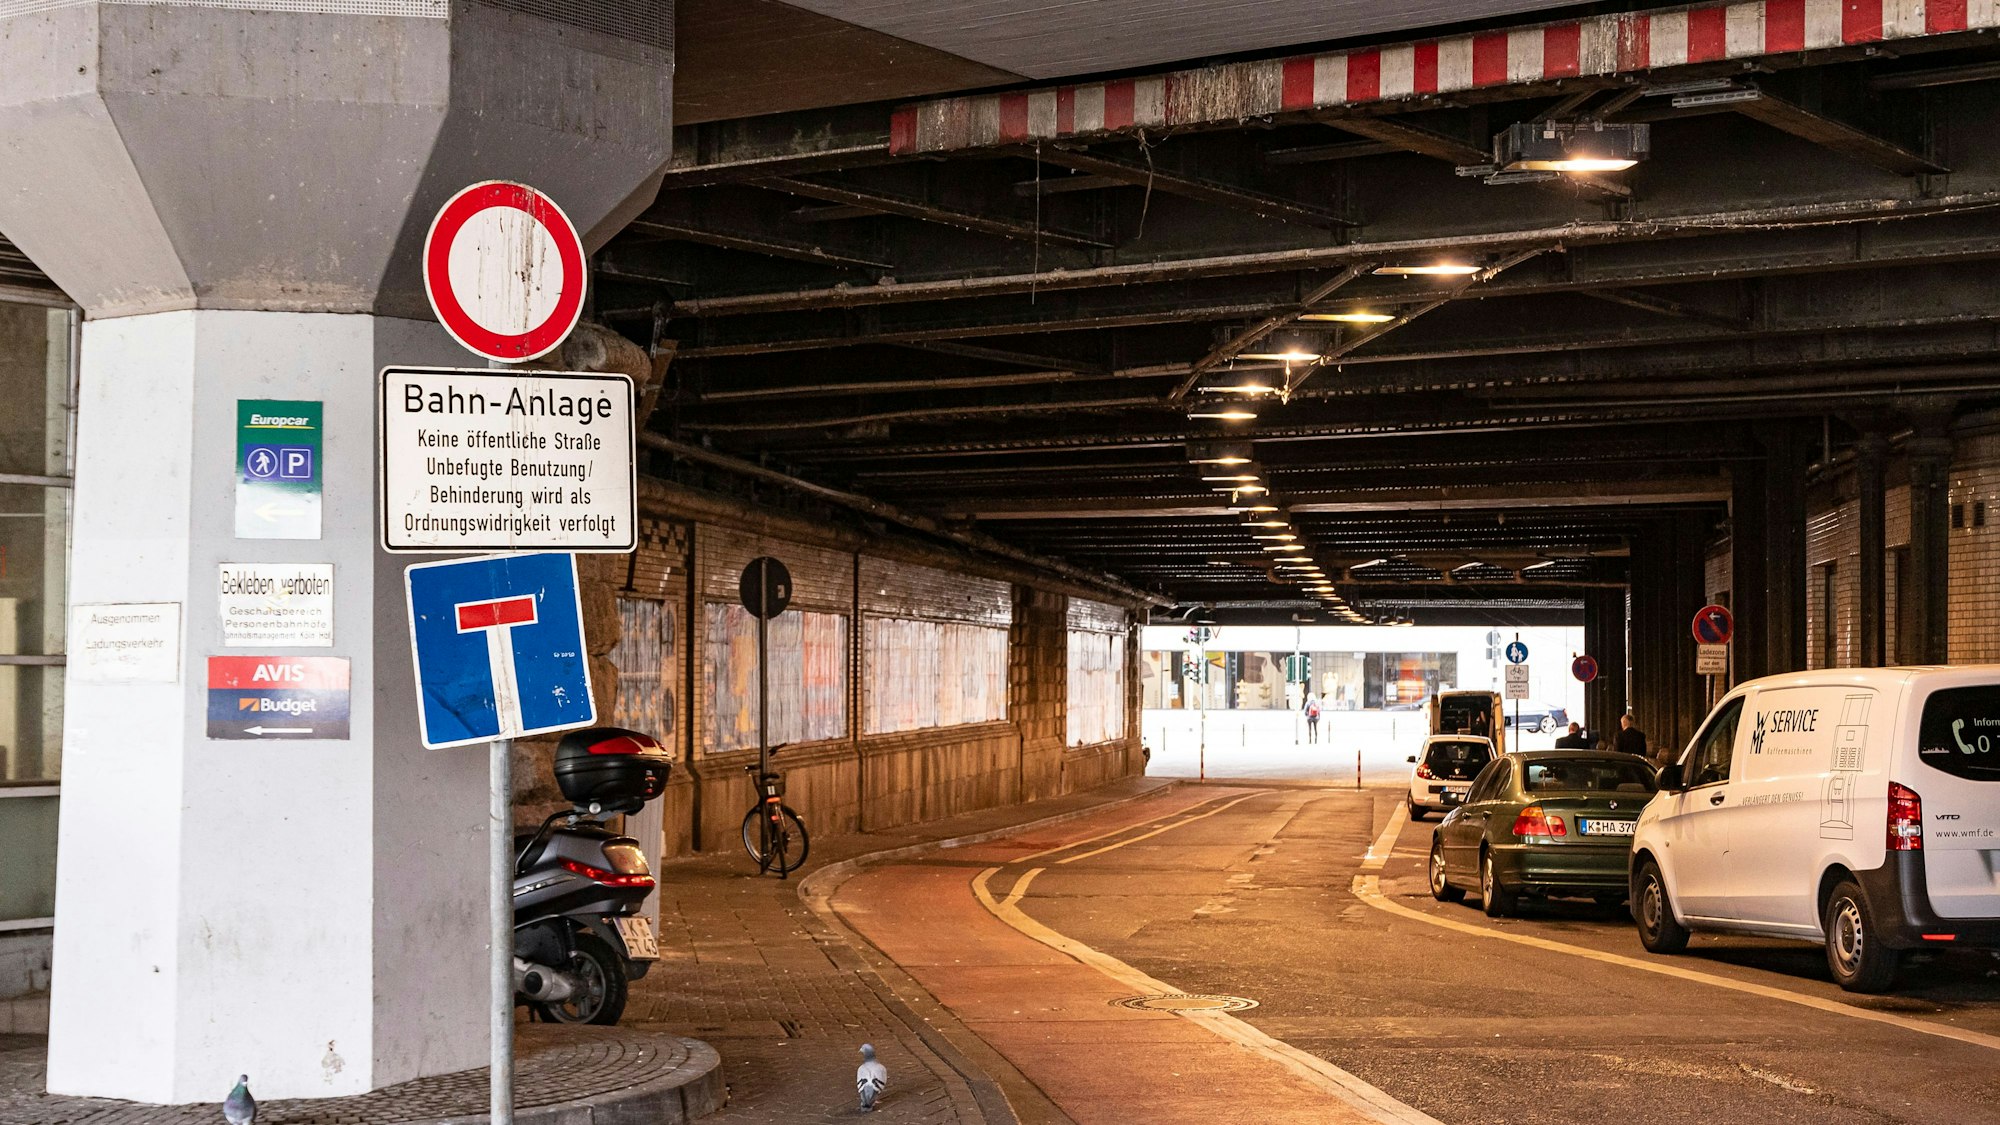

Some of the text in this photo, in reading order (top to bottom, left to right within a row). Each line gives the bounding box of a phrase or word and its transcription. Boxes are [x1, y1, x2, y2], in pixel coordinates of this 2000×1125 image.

[405, 384, 612, 425] Bahn-Anlage
[250, 414, 309, 428] Europcar
[418, 429, 601, 450] Keine öffentliche Straße
[288, 453, 305, 474] P
[427, 457, 593, 482] Unbefugte Benutzung/
[430, 485, 591, 509] Behinderung wird als
[404, 513, 616, 537] Ordnungswidrigkeit verfolgt
[222, 571, 330, 595] Bekleben verboten
[90, 613, 160, 627] Ausgenommen
[86, 637, 165, 652] Ladungsverkehr
[252, 663, 305, 683] AVIS
[260, 697, 317, 716] Budget
[1770, 709, 1819, 733] SERVICE
[1767, 747, 1813, 755] Kaffeemaschinen
[1588, 821, 1595, 832] K
[1602, 822, 1616, 832] HA
[1935, 828, 1994, 838] www.wmf.de
[626, 920, 638, 937] K
